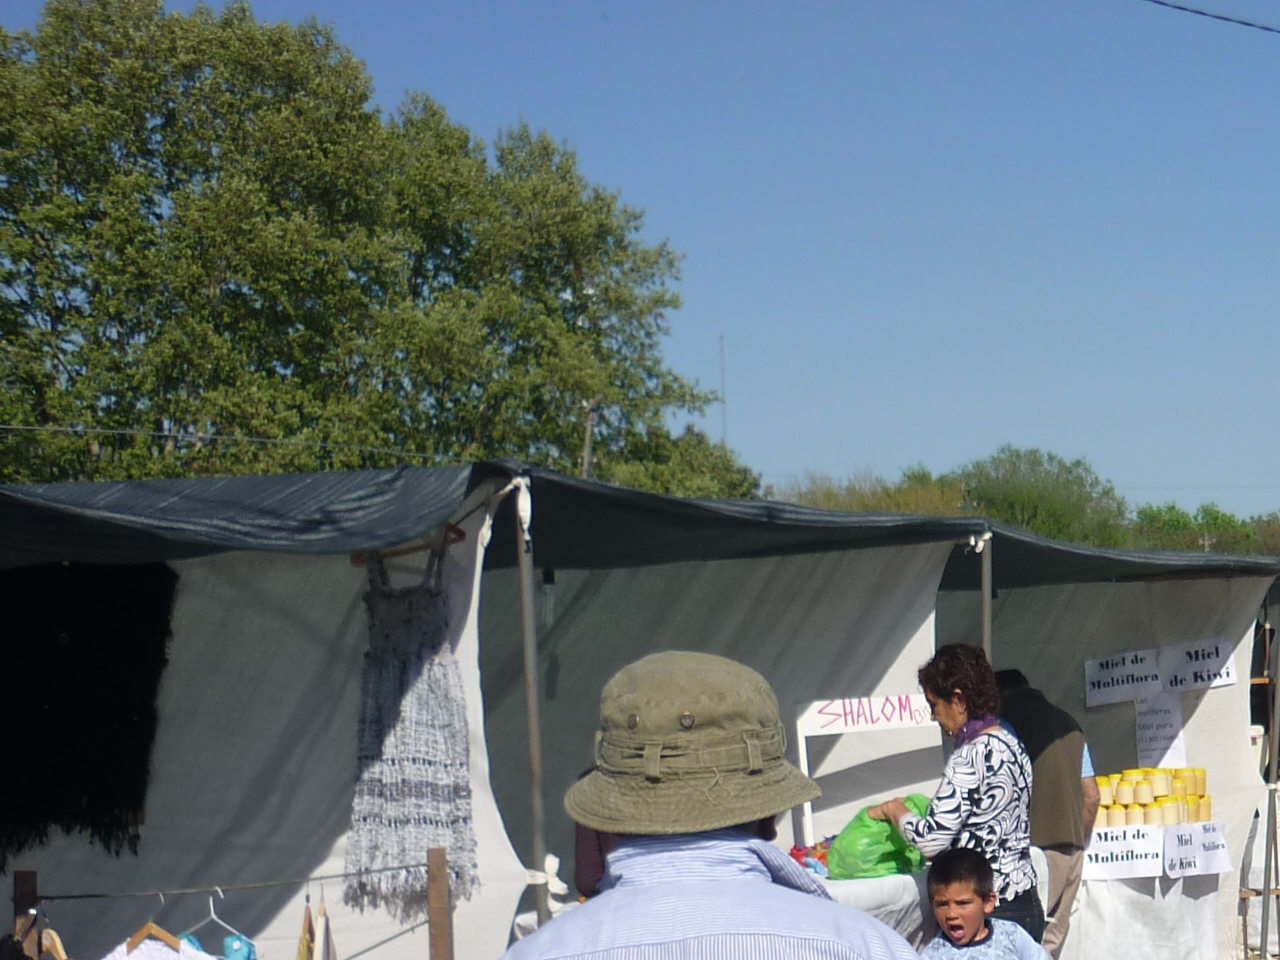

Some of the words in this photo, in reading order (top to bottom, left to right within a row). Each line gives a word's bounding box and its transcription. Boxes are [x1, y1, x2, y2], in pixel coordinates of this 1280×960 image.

[1098, 656, 1126, 672] Miel
[1130, 654, 1147, 666] de
[1184, 645, 1220, 664] Miel
[1089, 672, 1159, 692] Multiflora
[1169, 674, 1188, 688] de
[1192, 665, 1231, 684] Kiwi
[817, 694, 914, 729] SHALOM
[1096, 829, 1128, 843] Miel
[1132, 829, 1149, 841] de
[1176, 833, 1193, 848] Miel
[1086, 850, 1160, 865] Multiflora
[1168, 858, 1178, 872] de
[1178, 855, 1198, 871] Kiwi
